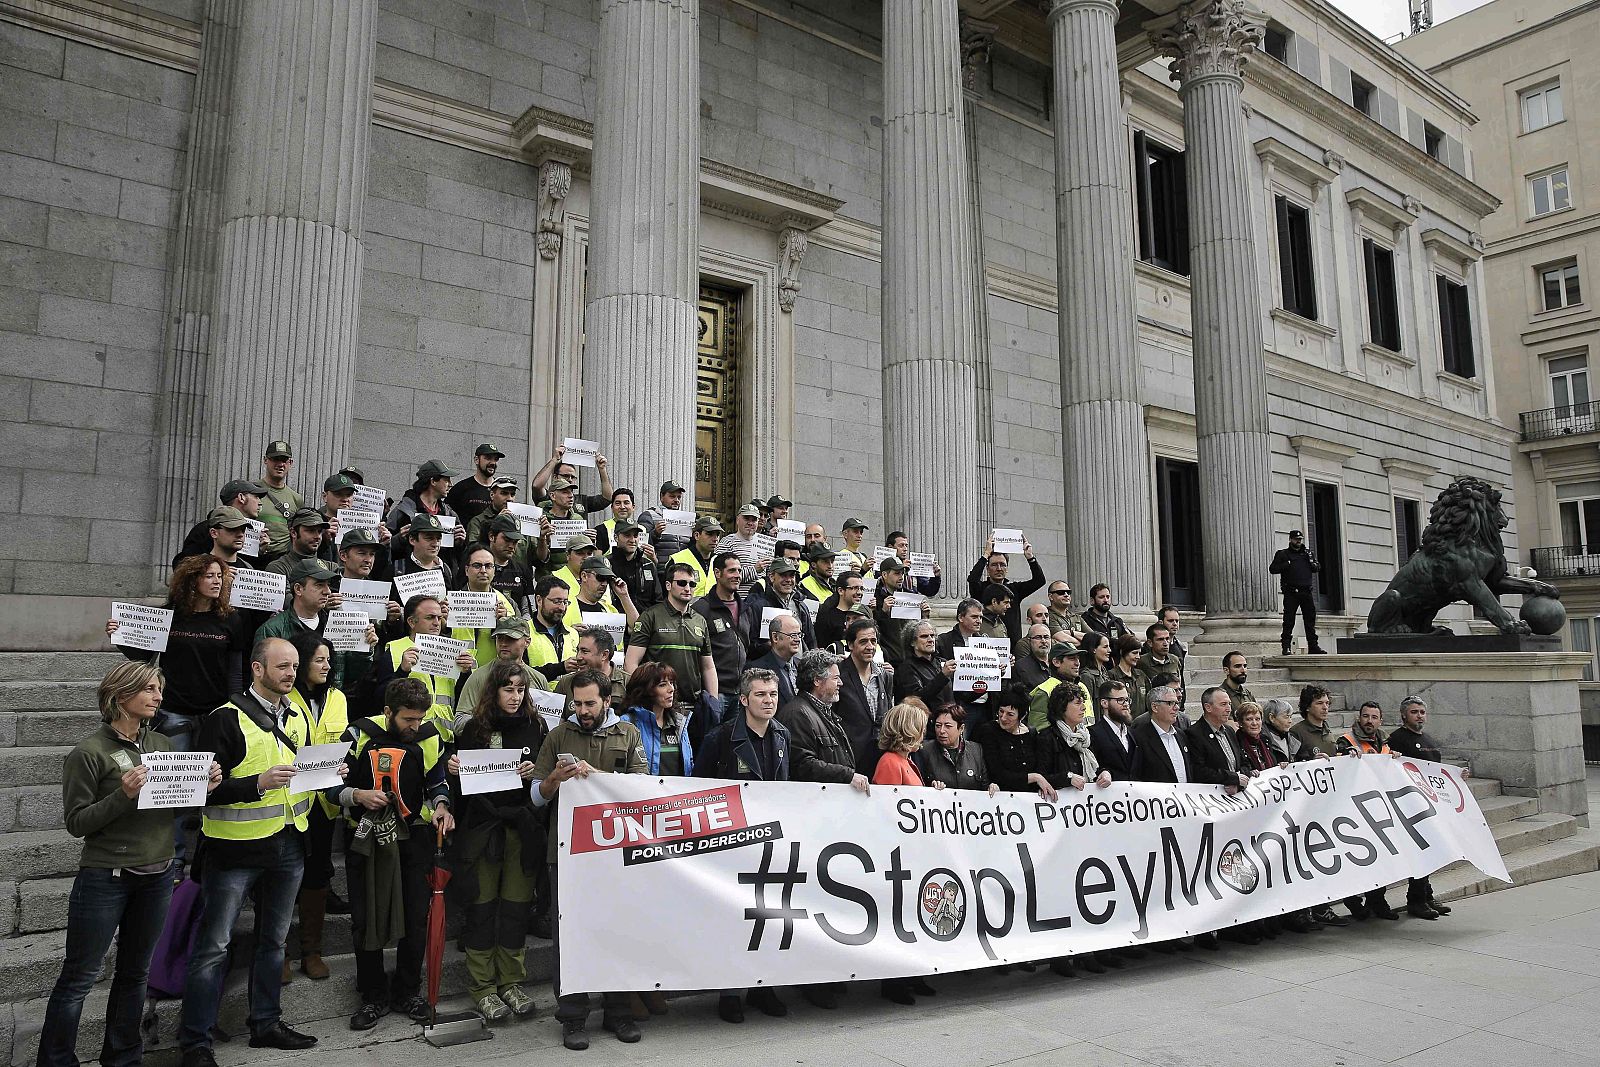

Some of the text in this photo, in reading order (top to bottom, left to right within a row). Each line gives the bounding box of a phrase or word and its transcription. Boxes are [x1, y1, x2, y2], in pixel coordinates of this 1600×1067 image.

[1428, 775, 1445, 789] FSP
[615, 793, 727, 815] Unión General de Trabajadores
[896, 798, 1025, 835] Sindicato
[1034, 792, 1187, 832] Profesional
[1253, 766, 1336, 806] FSP-UGT
[591, 802, 733, 847] ÚNETE
[632, 826, 772, 860] POR TUS DERECHOS
[737, 785, 1438, 960] #StopLeyMontesPP
[925, 886, 942, 900] UGT
